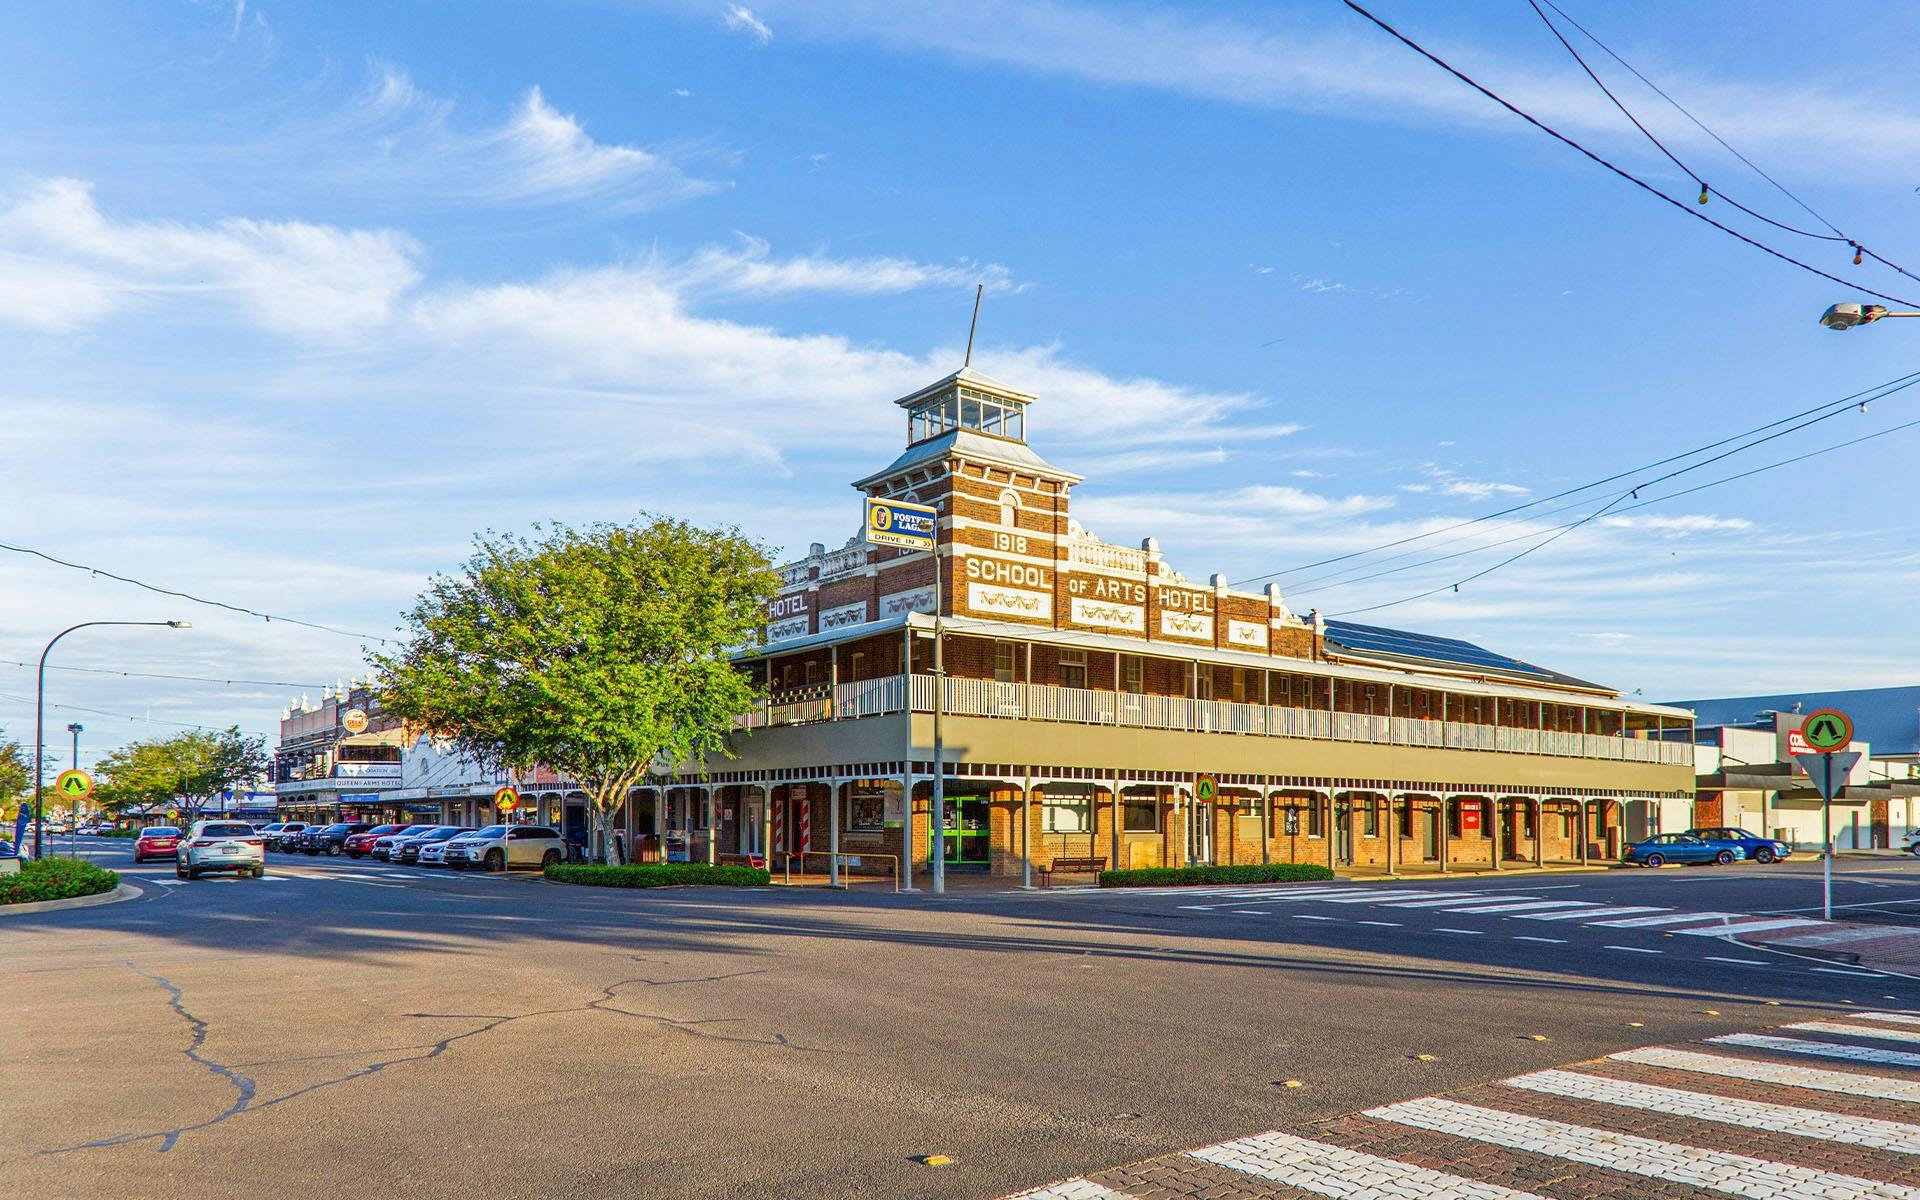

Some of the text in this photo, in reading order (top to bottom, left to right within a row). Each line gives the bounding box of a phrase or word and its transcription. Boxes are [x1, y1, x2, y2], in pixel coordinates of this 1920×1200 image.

[899, 521, 934, 532] LAG
[875, 533, 900, 543] DRIVE
[994, 532, 1027, 554] 1918
[966, 557, 1214, 613] SCHOOL OF ARTS HOTEL
[769, 594, 808, 618] HOTEL
